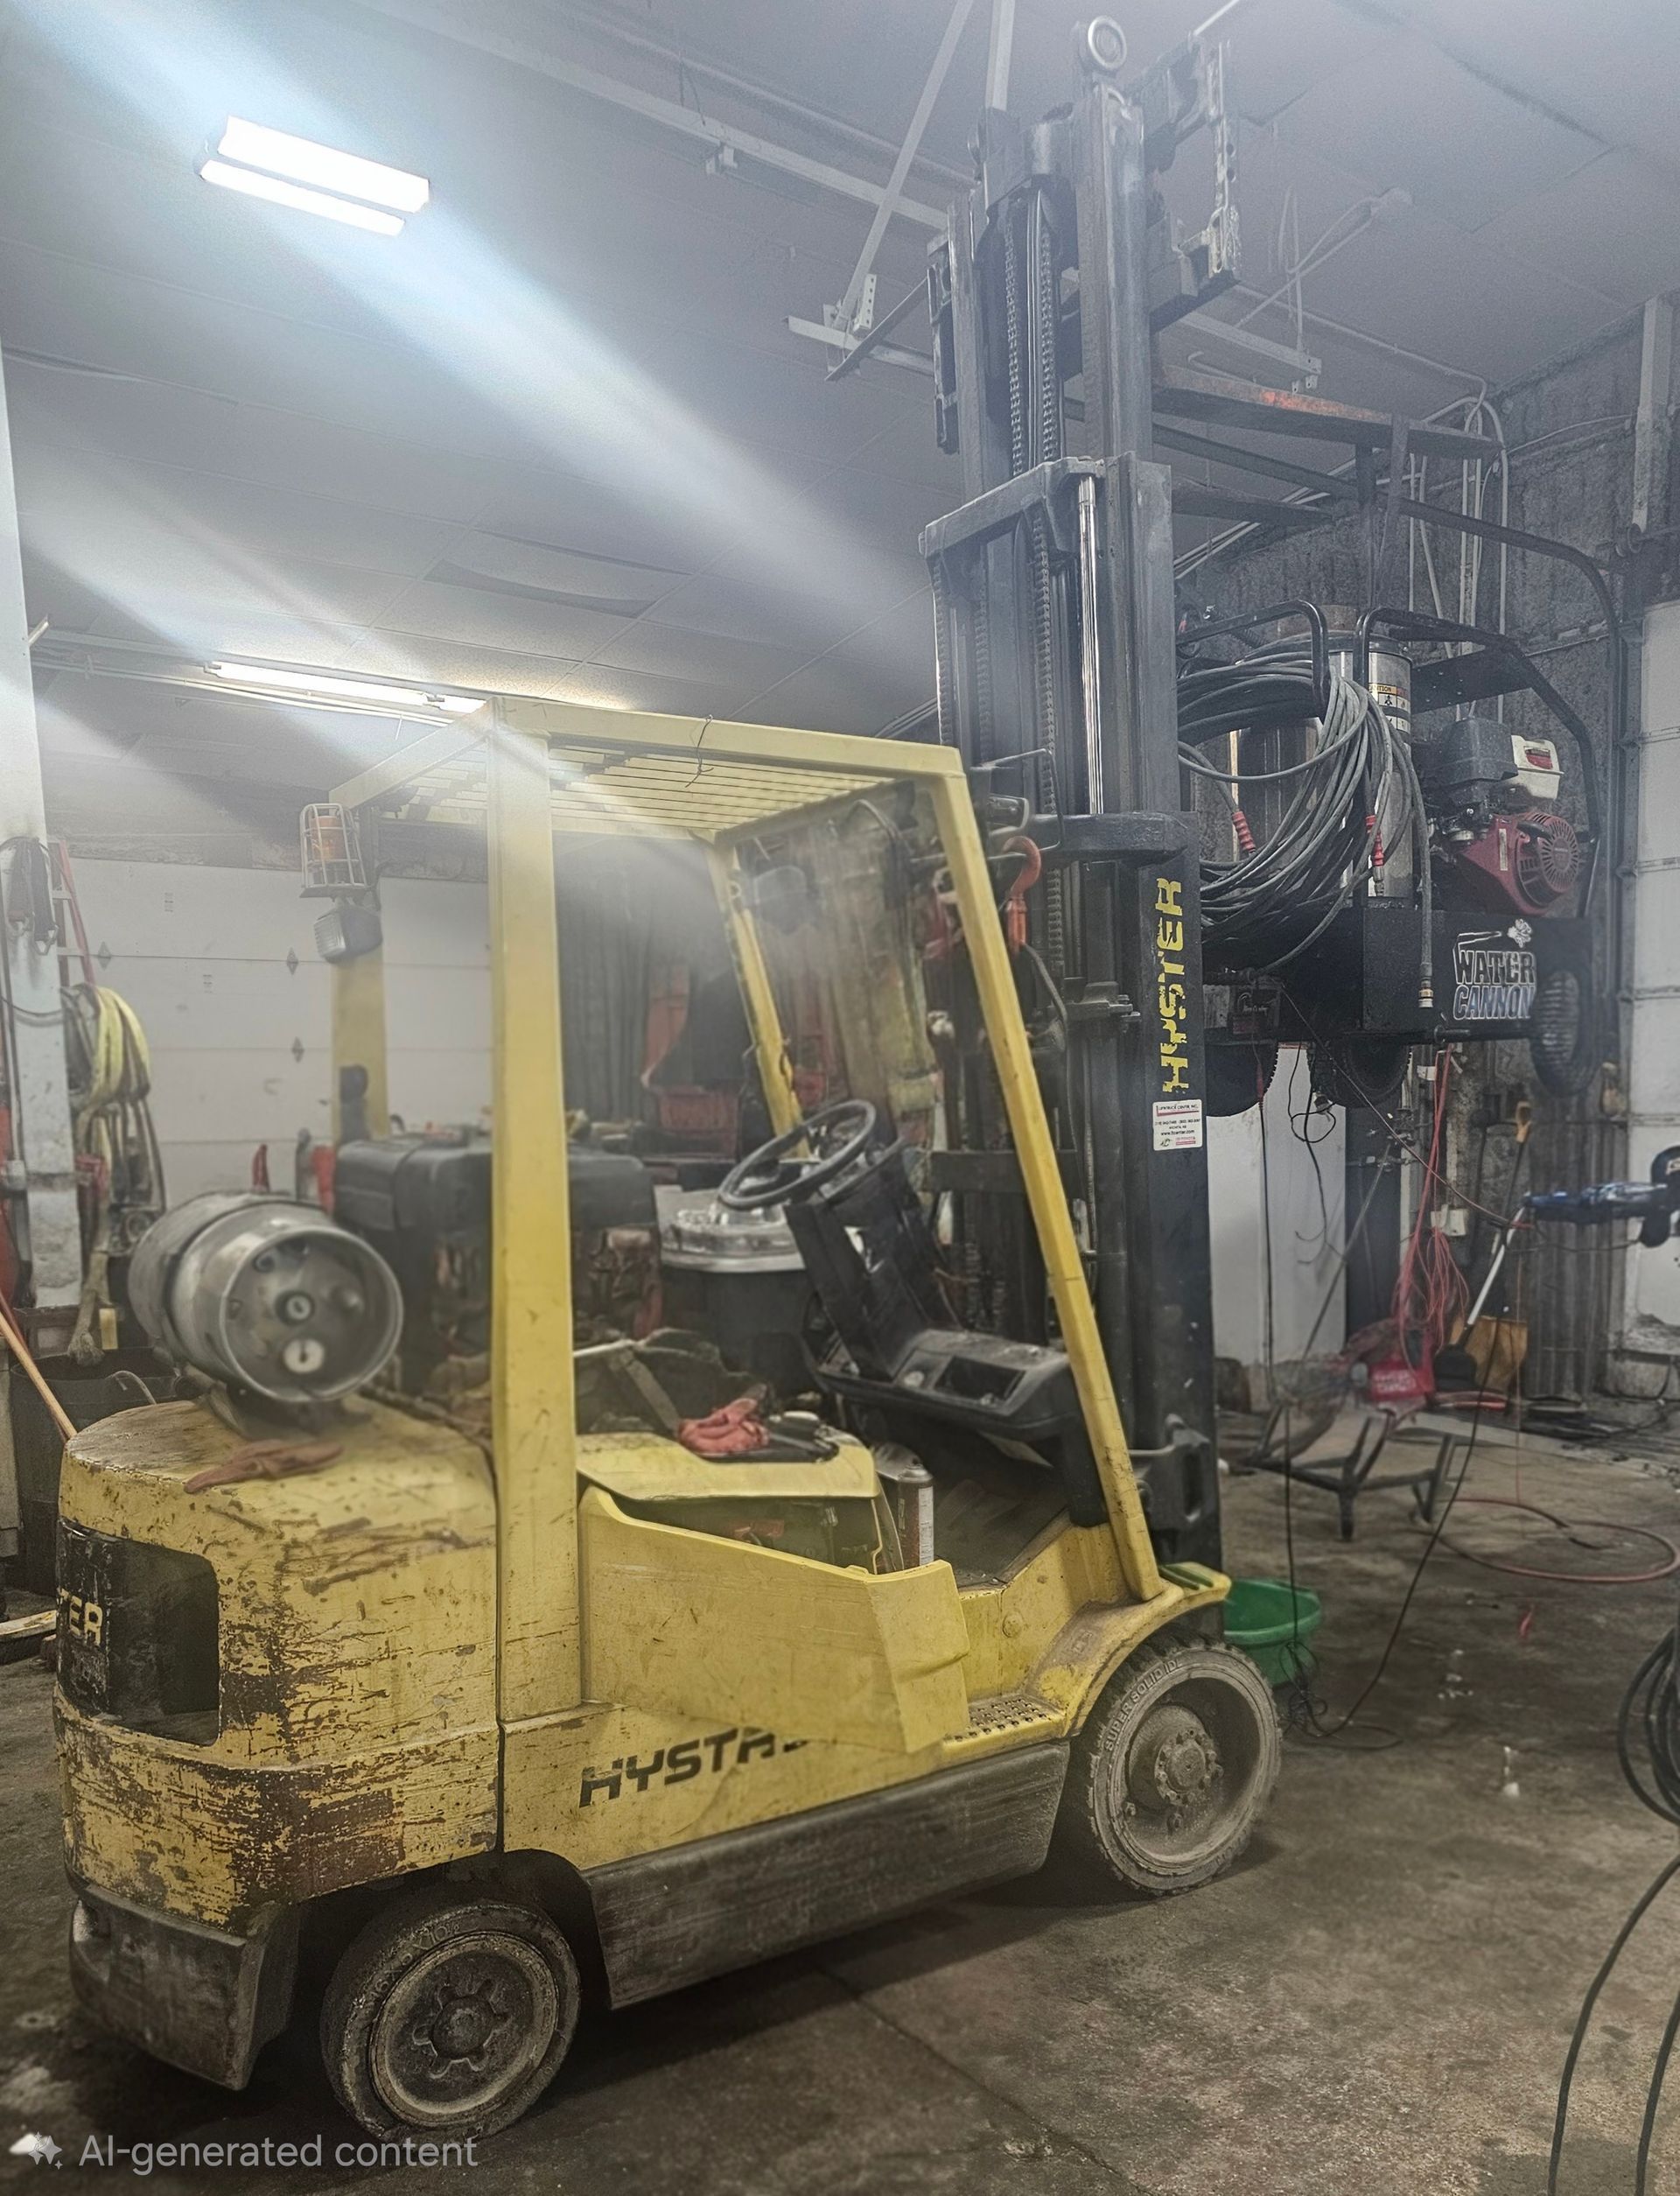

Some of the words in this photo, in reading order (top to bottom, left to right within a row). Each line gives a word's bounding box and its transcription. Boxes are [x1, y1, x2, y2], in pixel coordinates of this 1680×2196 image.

[1155, 878, 1190, 1092] HYSTER
[1454, 950, 1537, 985] WATER
[1452, 985, 1536, 1021] CANNON
[1104, 1702, 1133, 1751] SUPER
[1130, 1667, 1164, 1703] SOLID
